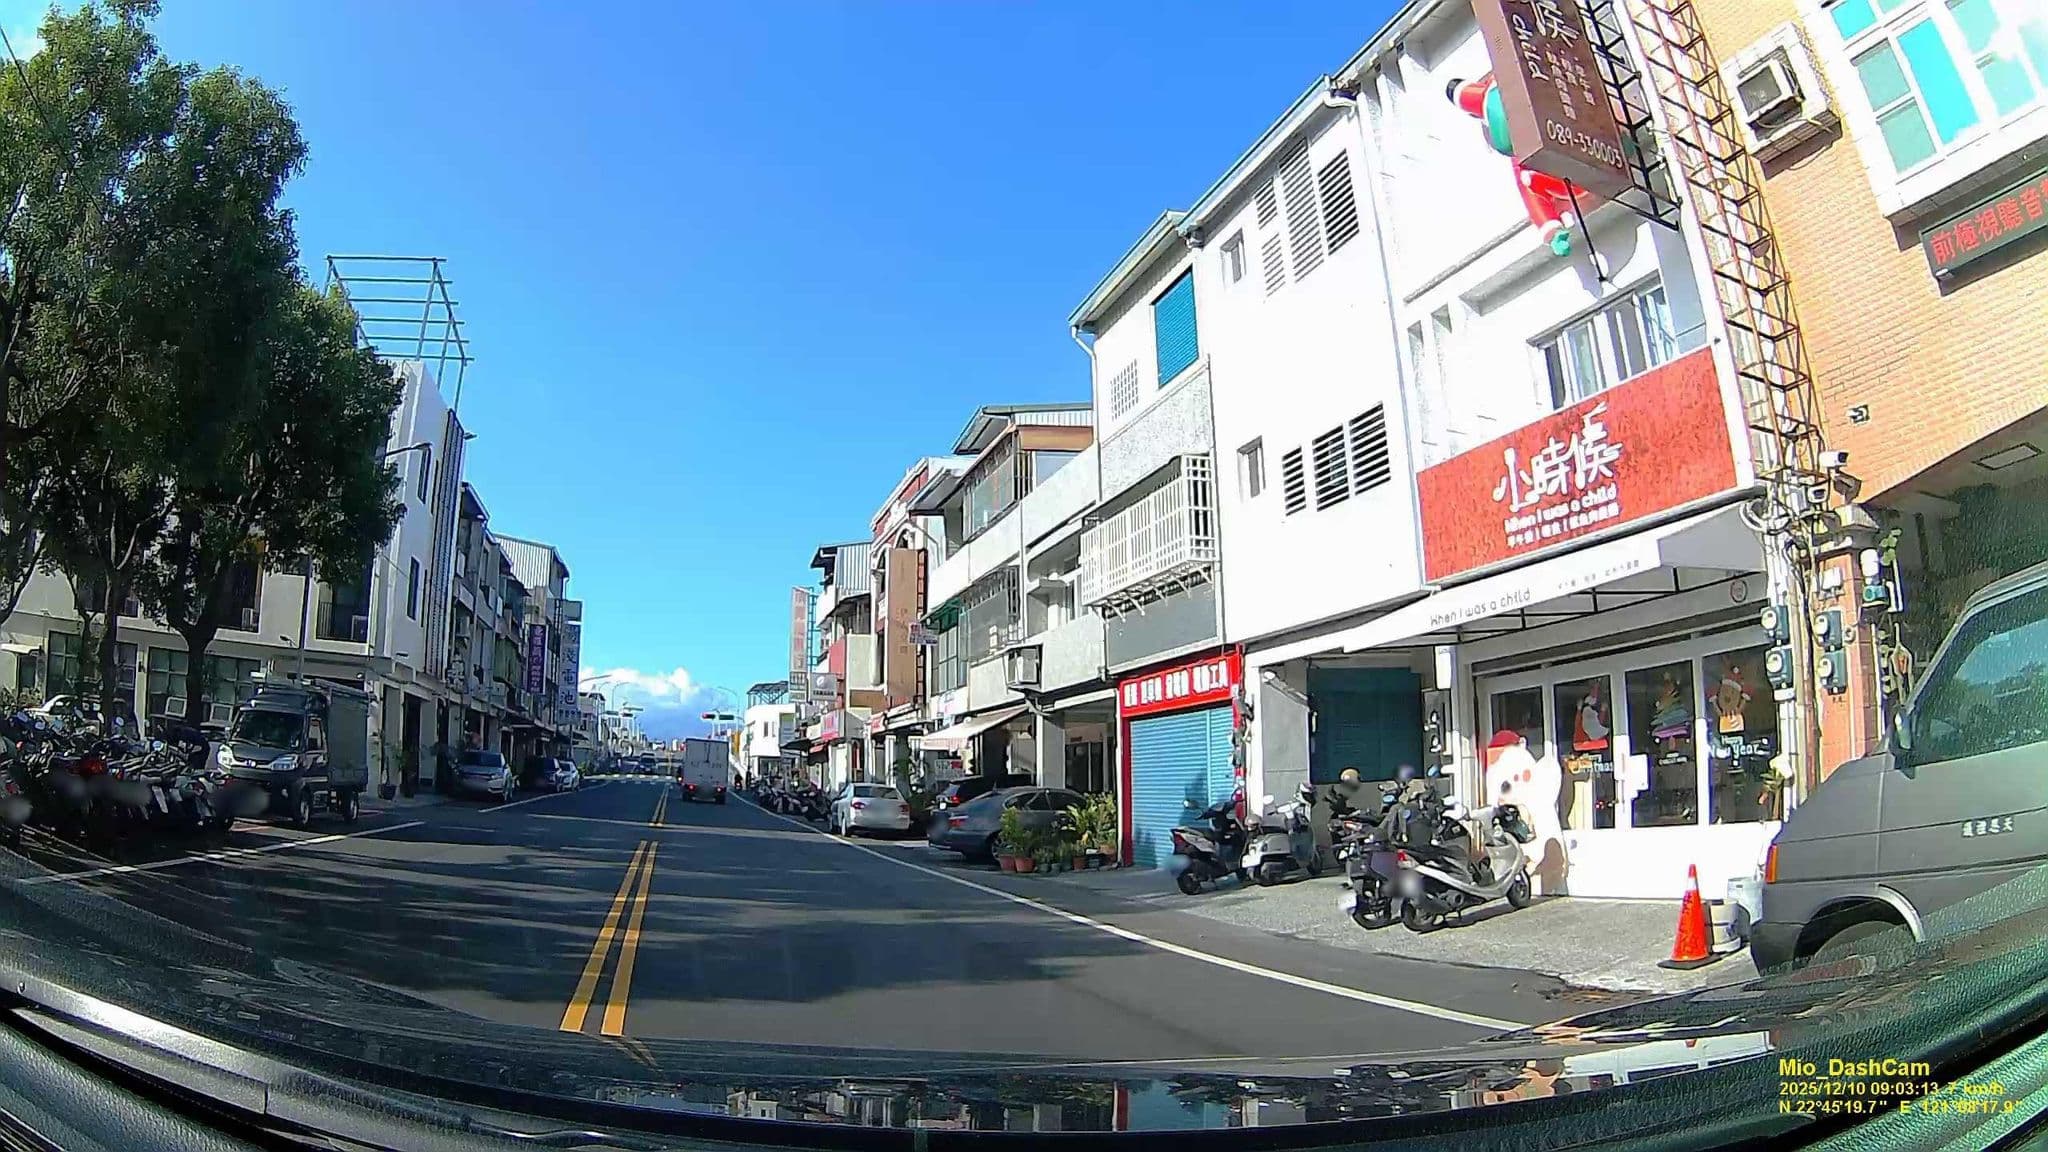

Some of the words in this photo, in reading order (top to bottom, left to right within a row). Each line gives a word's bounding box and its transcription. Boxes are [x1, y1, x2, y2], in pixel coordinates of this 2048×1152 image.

[1545, 119, 1624, 169] 089-330003
[1929, 178, 2048, 266] 前極視聽音
[1492, 400, 1624, 513] 小時候
[1504, 513, 1537, 534] When
[1543, 502, 1570, 522] was
[1581, 482, 1618, 507] child
[1429, 610, 1457, 628] When
[1465, 603, 1488, 618] was
[1499, 587, 1531, 609] child
